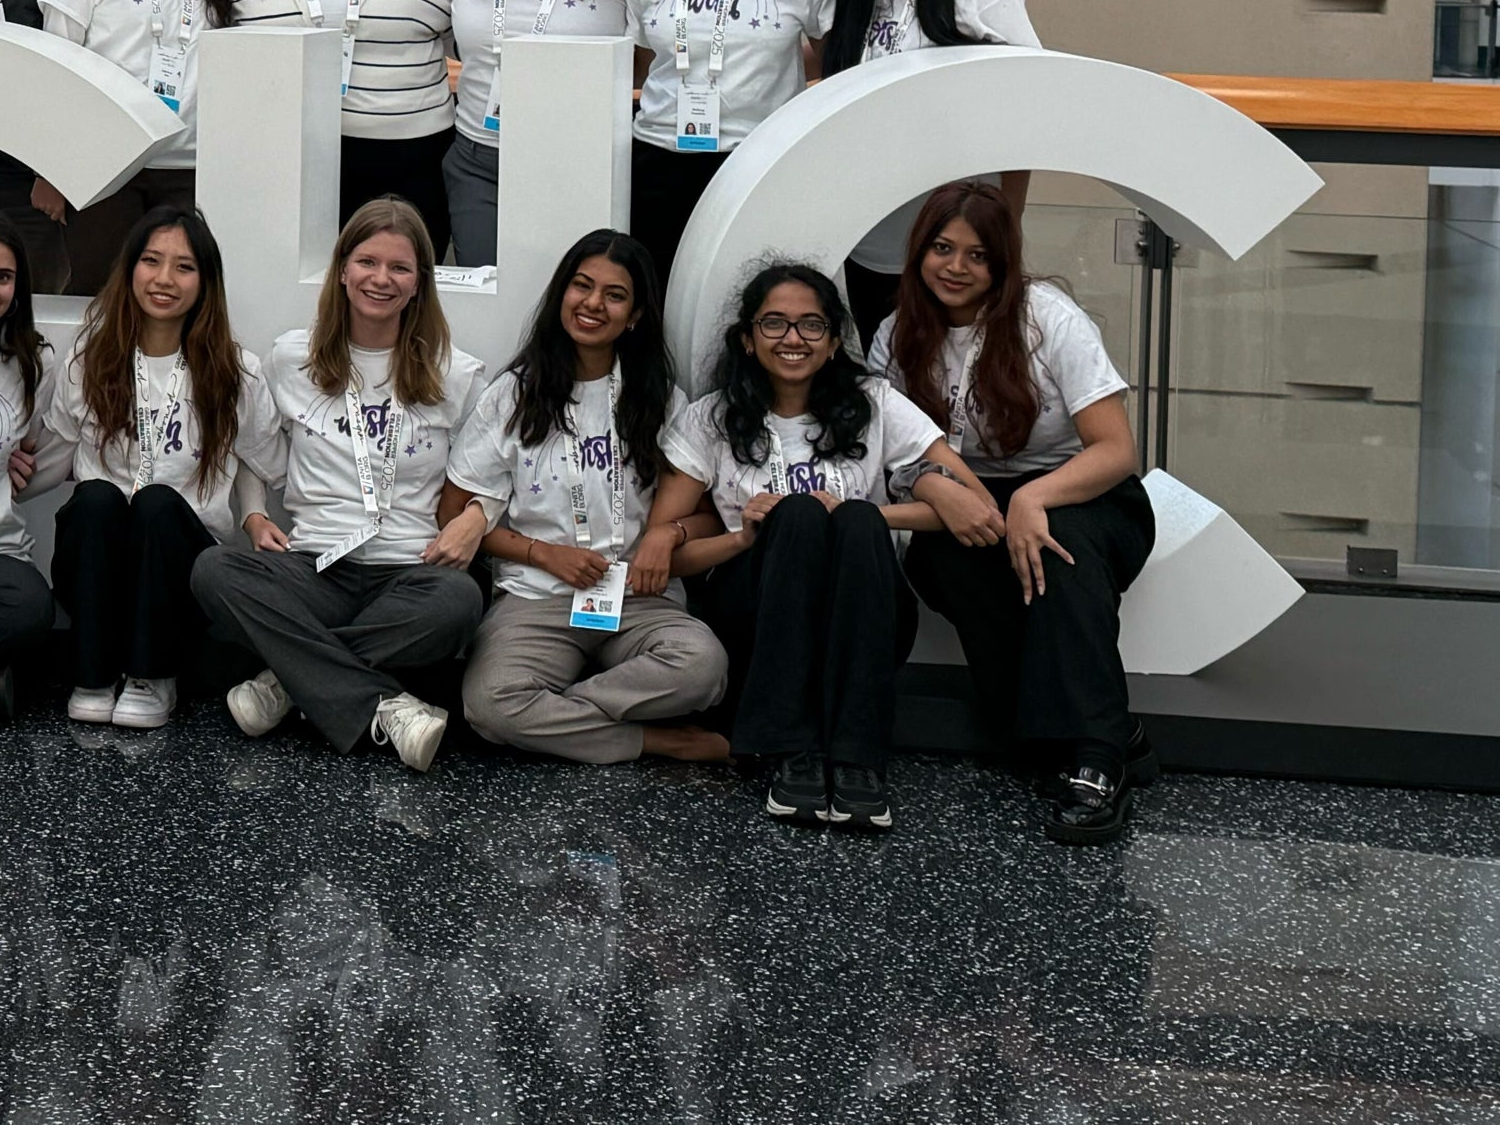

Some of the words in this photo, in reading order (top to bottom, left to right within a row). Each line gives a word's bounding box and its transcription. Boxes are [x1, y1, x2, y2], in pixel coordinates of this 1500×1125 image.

[493, 10, 504, 35] 2025
[711, 28, 724, 55] 2025
[138, 407, 146, 452] CELEBRATION
[385, 413, 396, 458] CELEBRATION
[141, 453, 154, 484] 2025
[381, 459, 395, 491] 2025
[771, 462, 780, 492] CELEBRA
[613, 492, 625, 525] 2025
